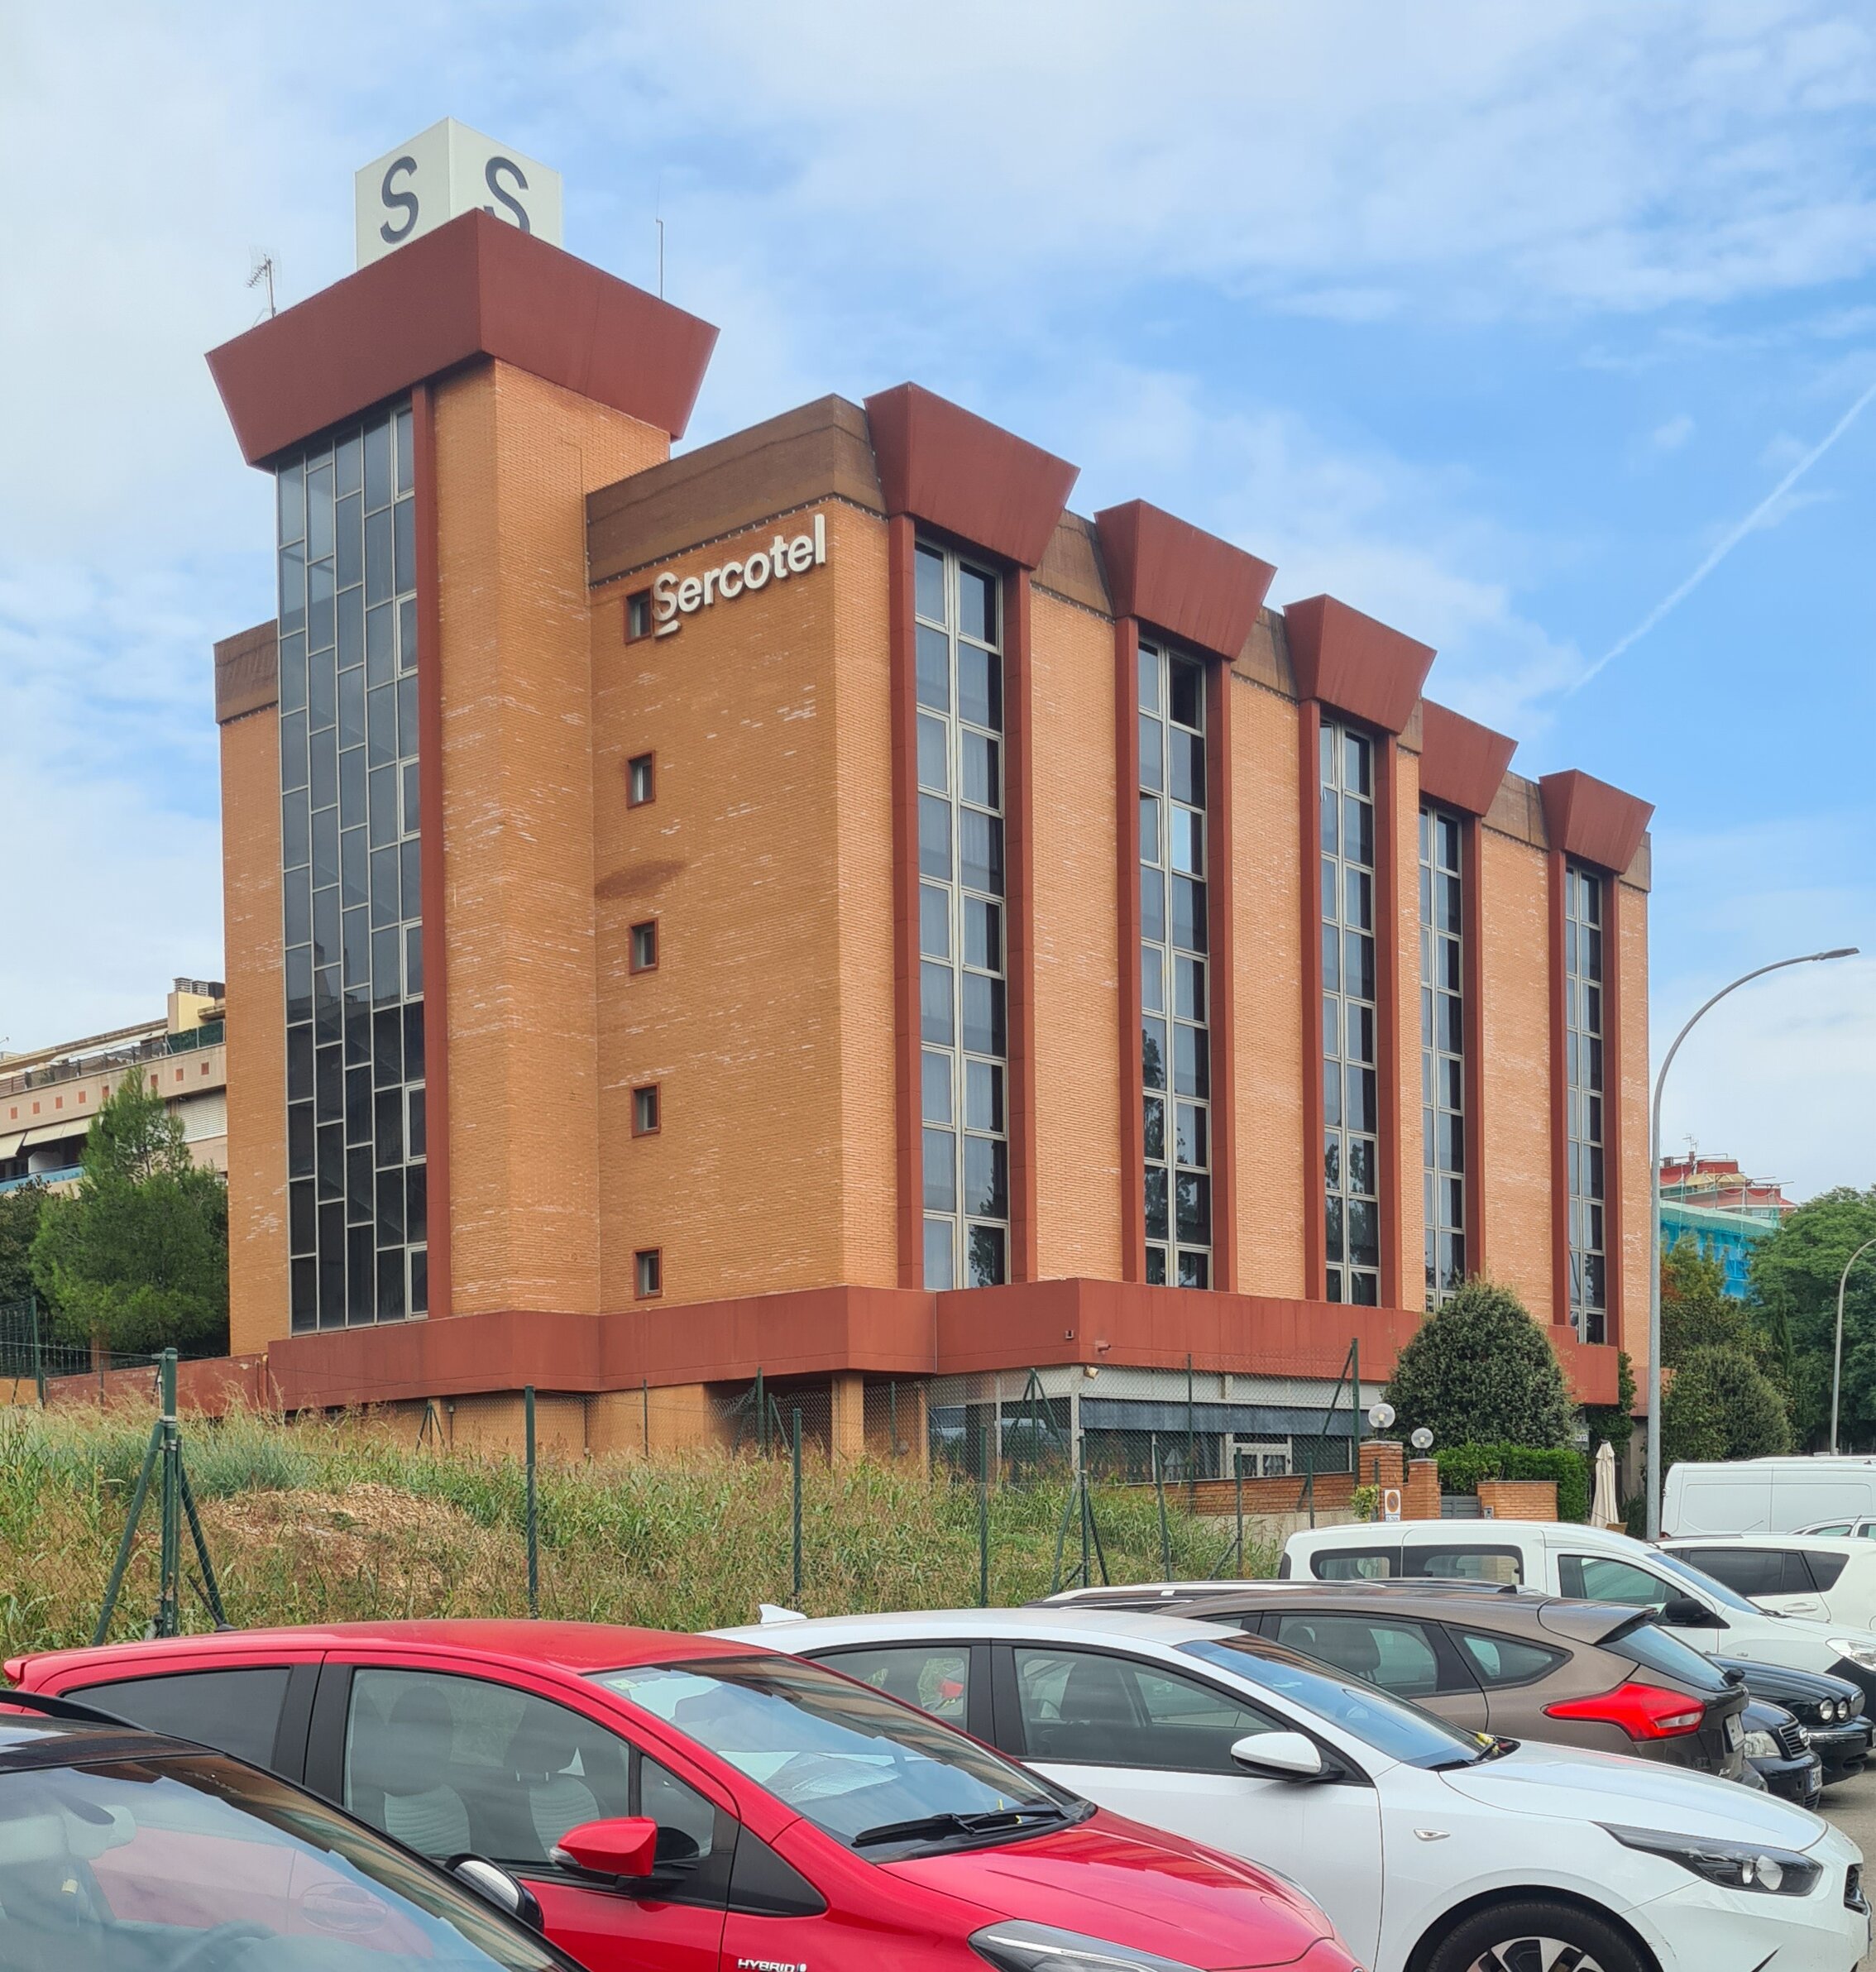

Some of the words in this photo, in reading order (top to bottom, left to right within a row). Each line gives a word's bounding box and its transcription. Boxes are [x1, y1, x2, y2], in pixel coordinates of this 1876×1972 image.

[380, 156, 419, 245] S
[484, 156, 530, 235] S
[653, 513, 827, 638] Sercotel
[737, 1958, 796, 1972] HYBRID
